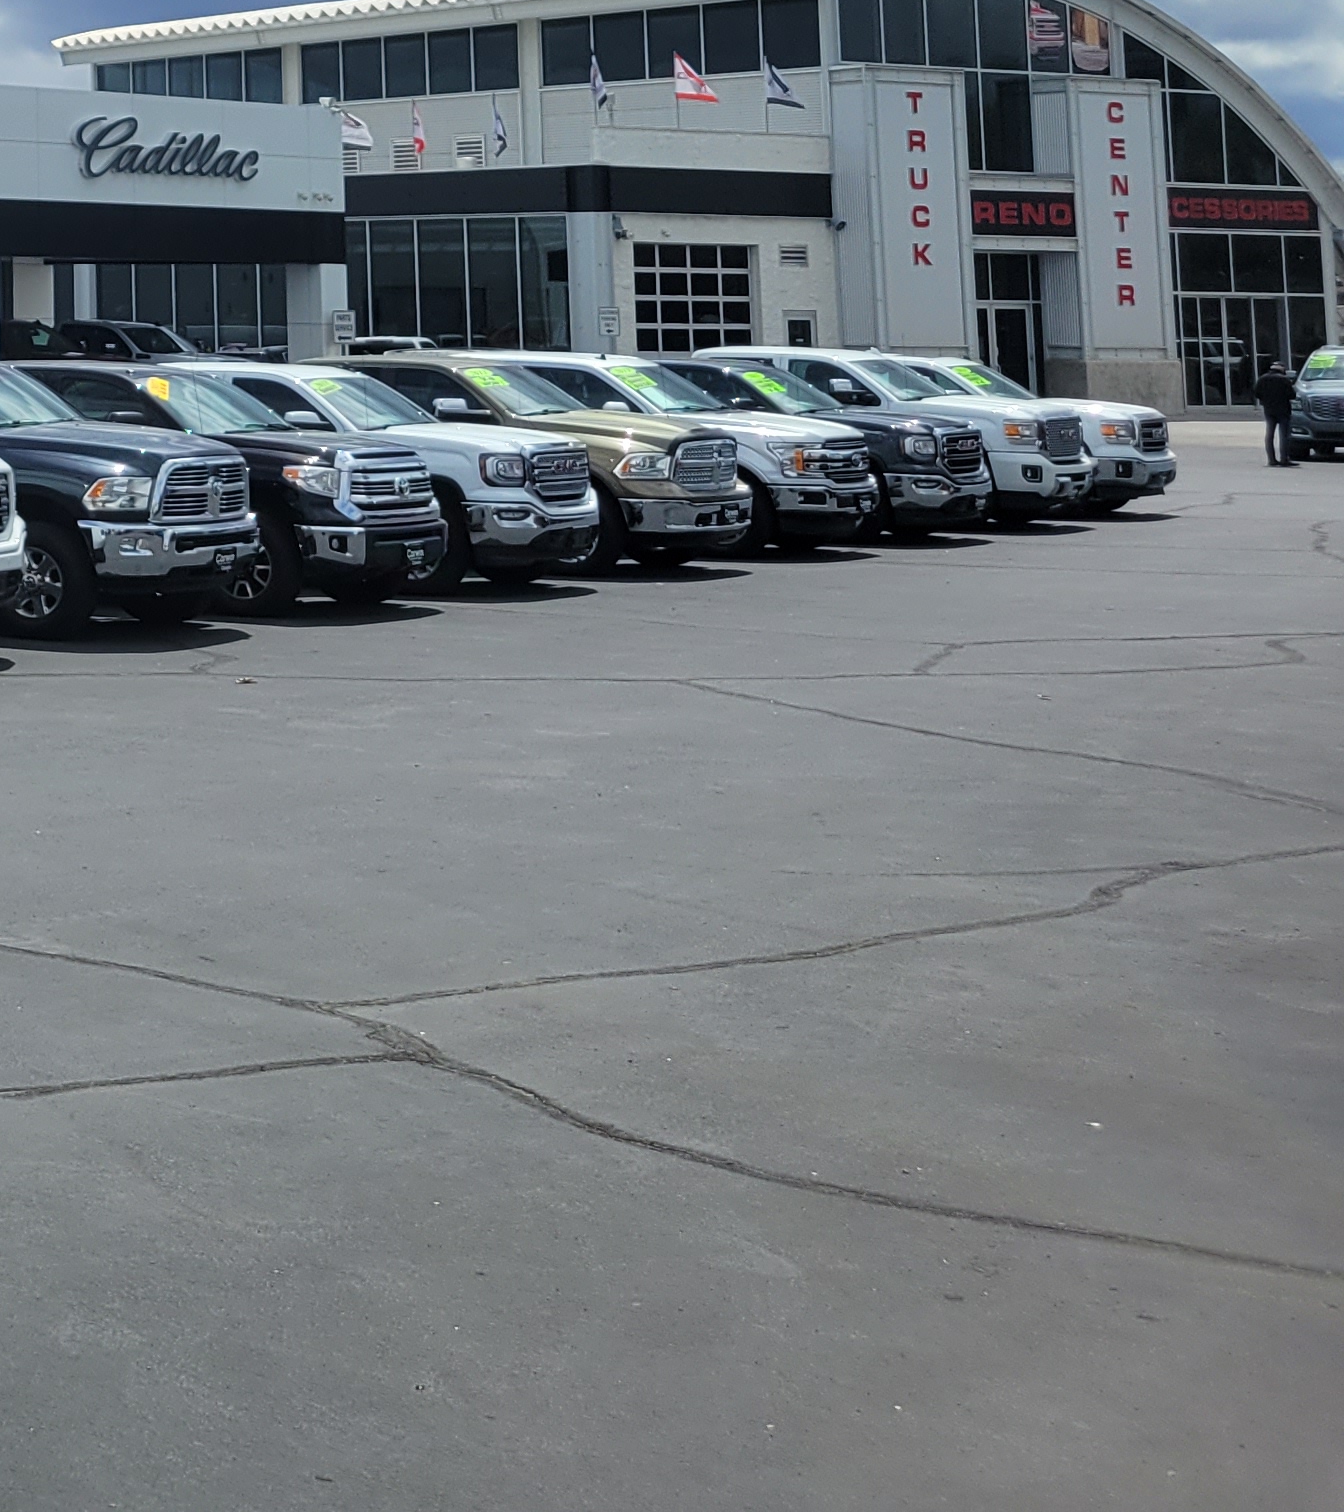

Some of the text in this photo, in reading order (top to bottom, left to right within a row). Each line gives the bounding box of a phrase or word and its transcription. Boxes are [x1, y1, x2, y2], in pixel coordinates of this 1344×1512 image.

[76, 115, 260, 181] Cadillac
[906, 91, 933, 266] TRUCK
[973, 201, 1073, 226] RENO
[1107, 101, 1136, 306] CENTER
[1170, 196, 1309, 221] CESSORIES
